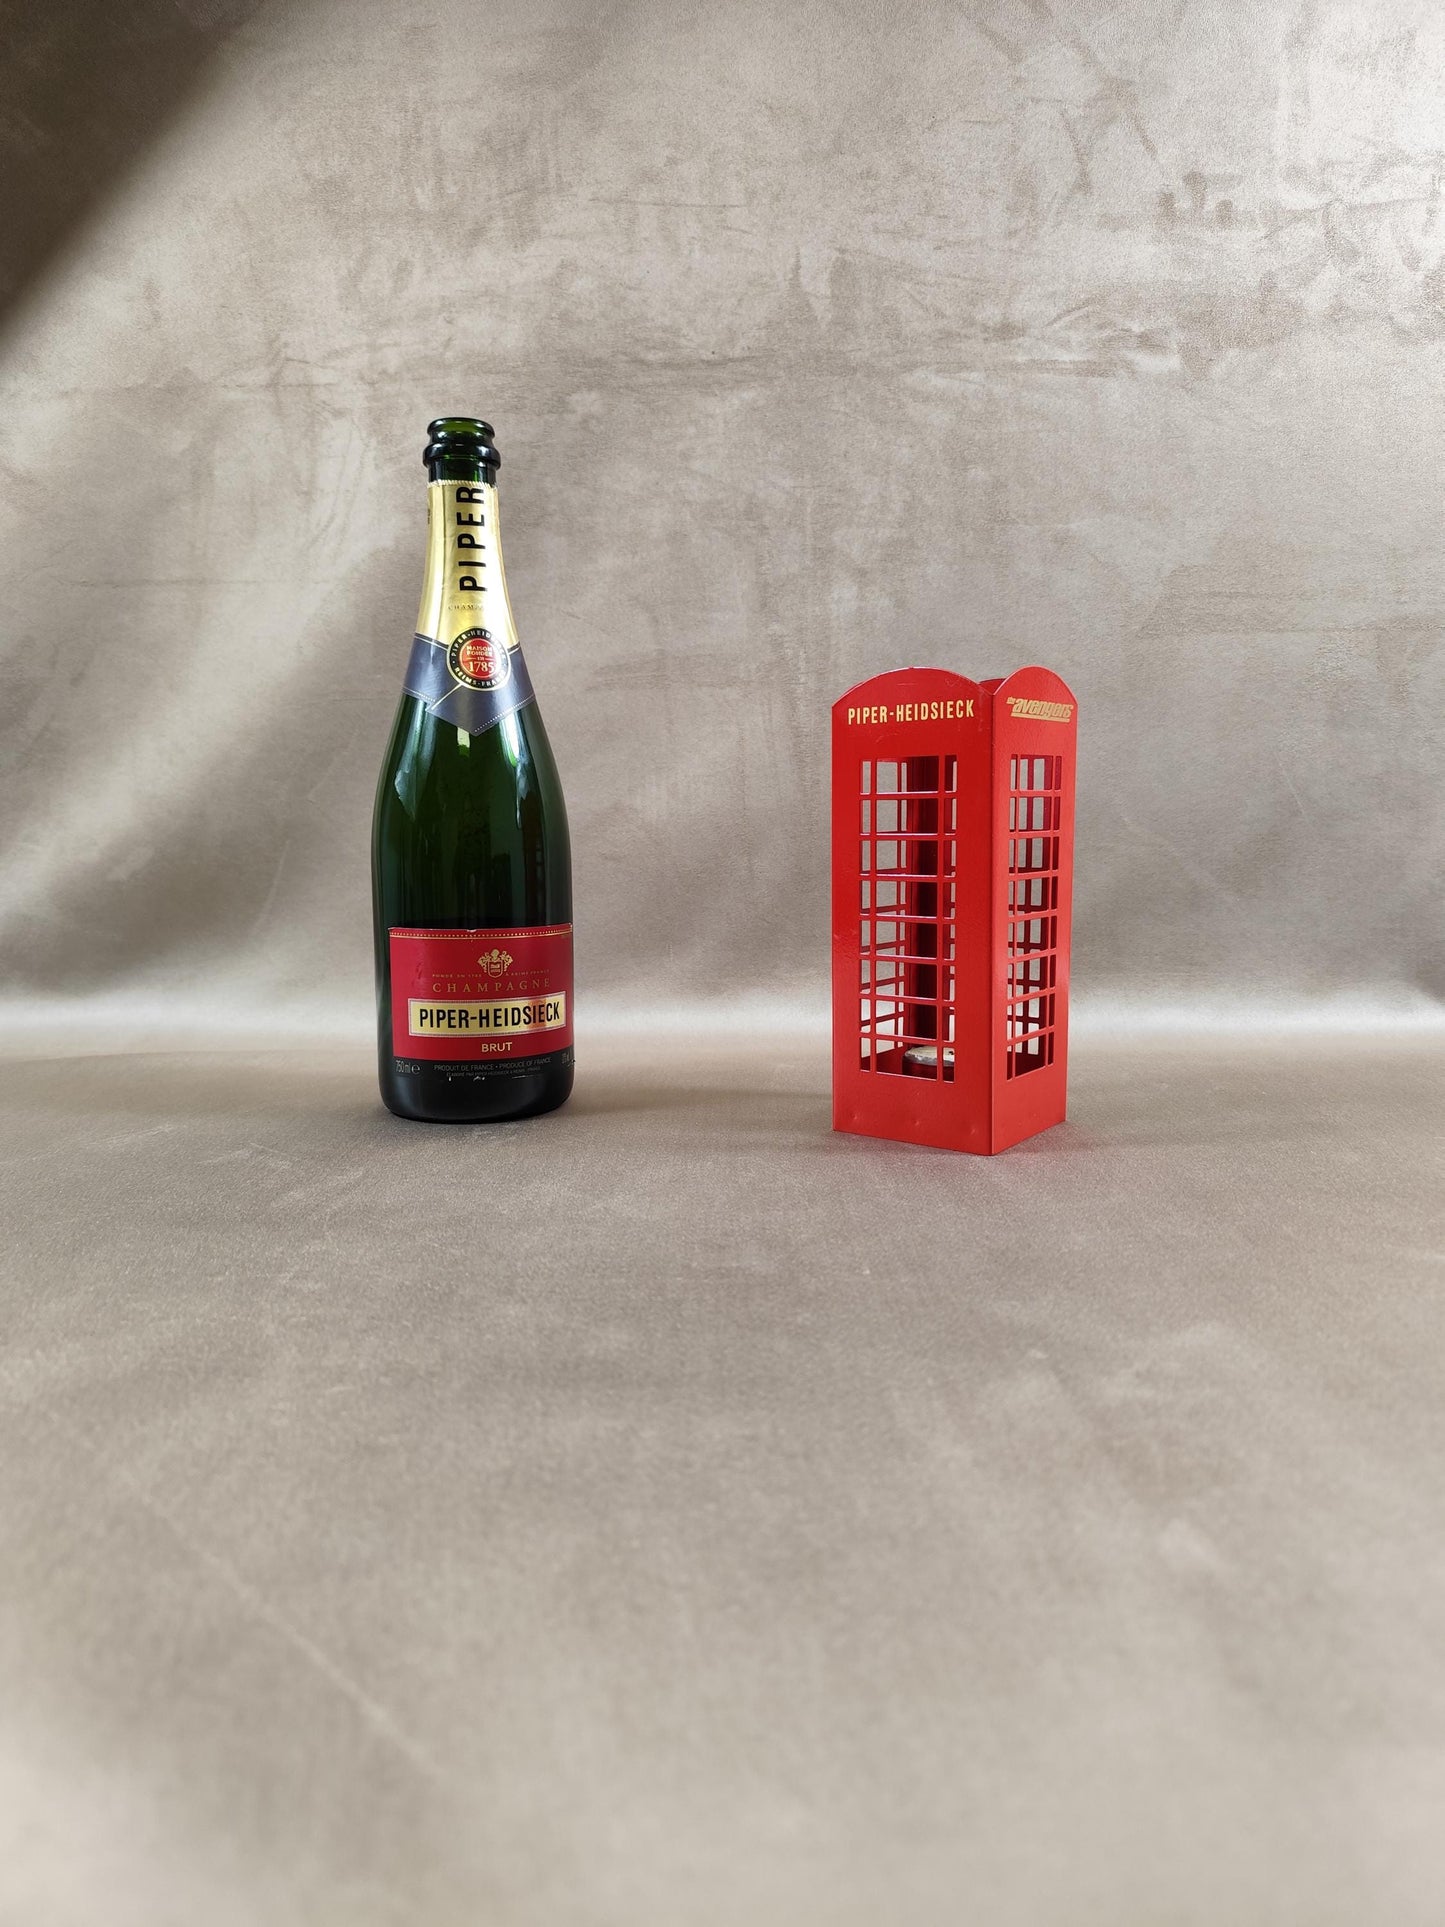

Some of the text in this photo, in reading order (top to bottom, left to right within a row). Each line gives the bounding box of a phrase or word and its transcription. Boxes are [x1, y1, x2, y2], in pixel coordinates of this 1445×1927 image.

[456, 486, 488, 592] PIPER
[469, 661, 495, 673] 1785
[848, 699, 974, 725] PIPER-HEIDSIECK
[432, 978, 550, 993] CHAMPAGNE
[419, 1001, 560, 1029] PIPER-HEIDSIECK
[481, 1041, 512, 1053] BRUT
